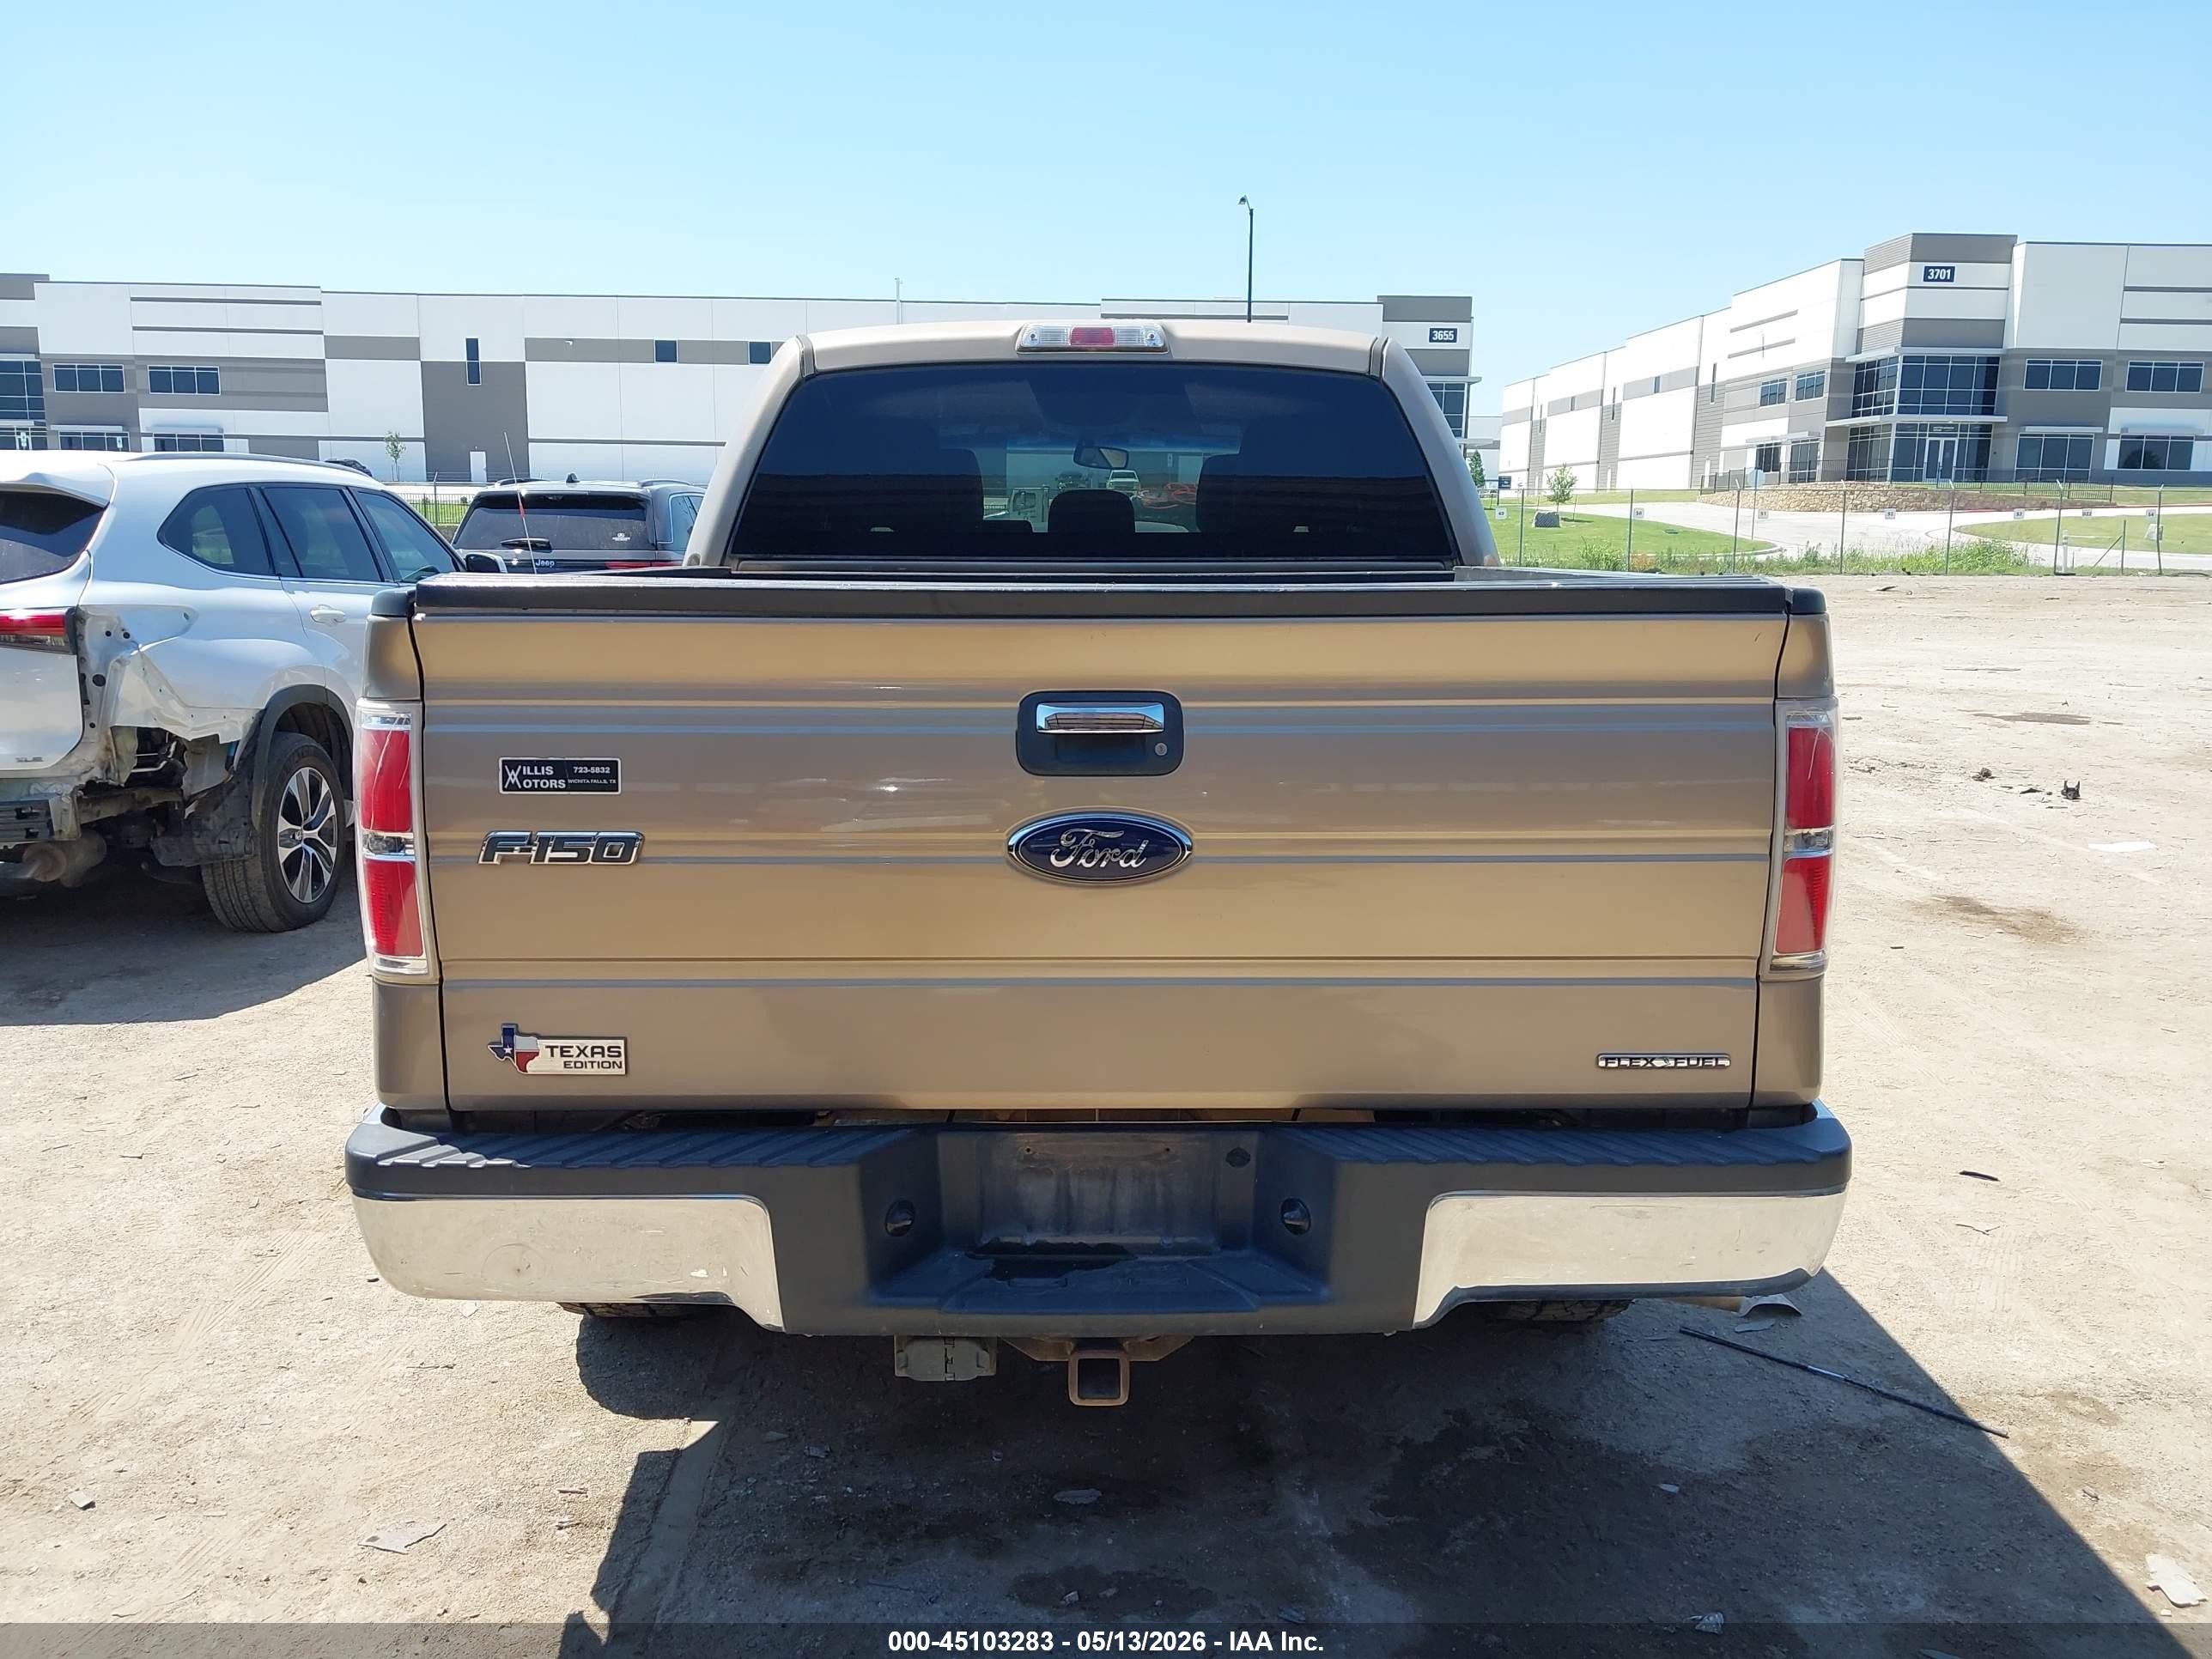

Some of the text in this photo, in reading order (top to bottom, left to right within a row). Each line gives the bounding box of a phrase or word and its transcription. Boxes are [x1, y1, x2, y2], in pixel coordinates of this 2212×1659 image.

[1927, 268, 1952, 280] 3701
[1431, 330, 1455, 341] 3655
[535, 558, 556, 568] Jeep
[477, 830, 645, 866] F-150
[1049, 828, 1150, 869] Ford
[544, 1045, 623, 1059] TEXAS
[562, 1060, 623, 1070] EDITION
[1603, 1056, 1728, 1068] FLEX FUEL
